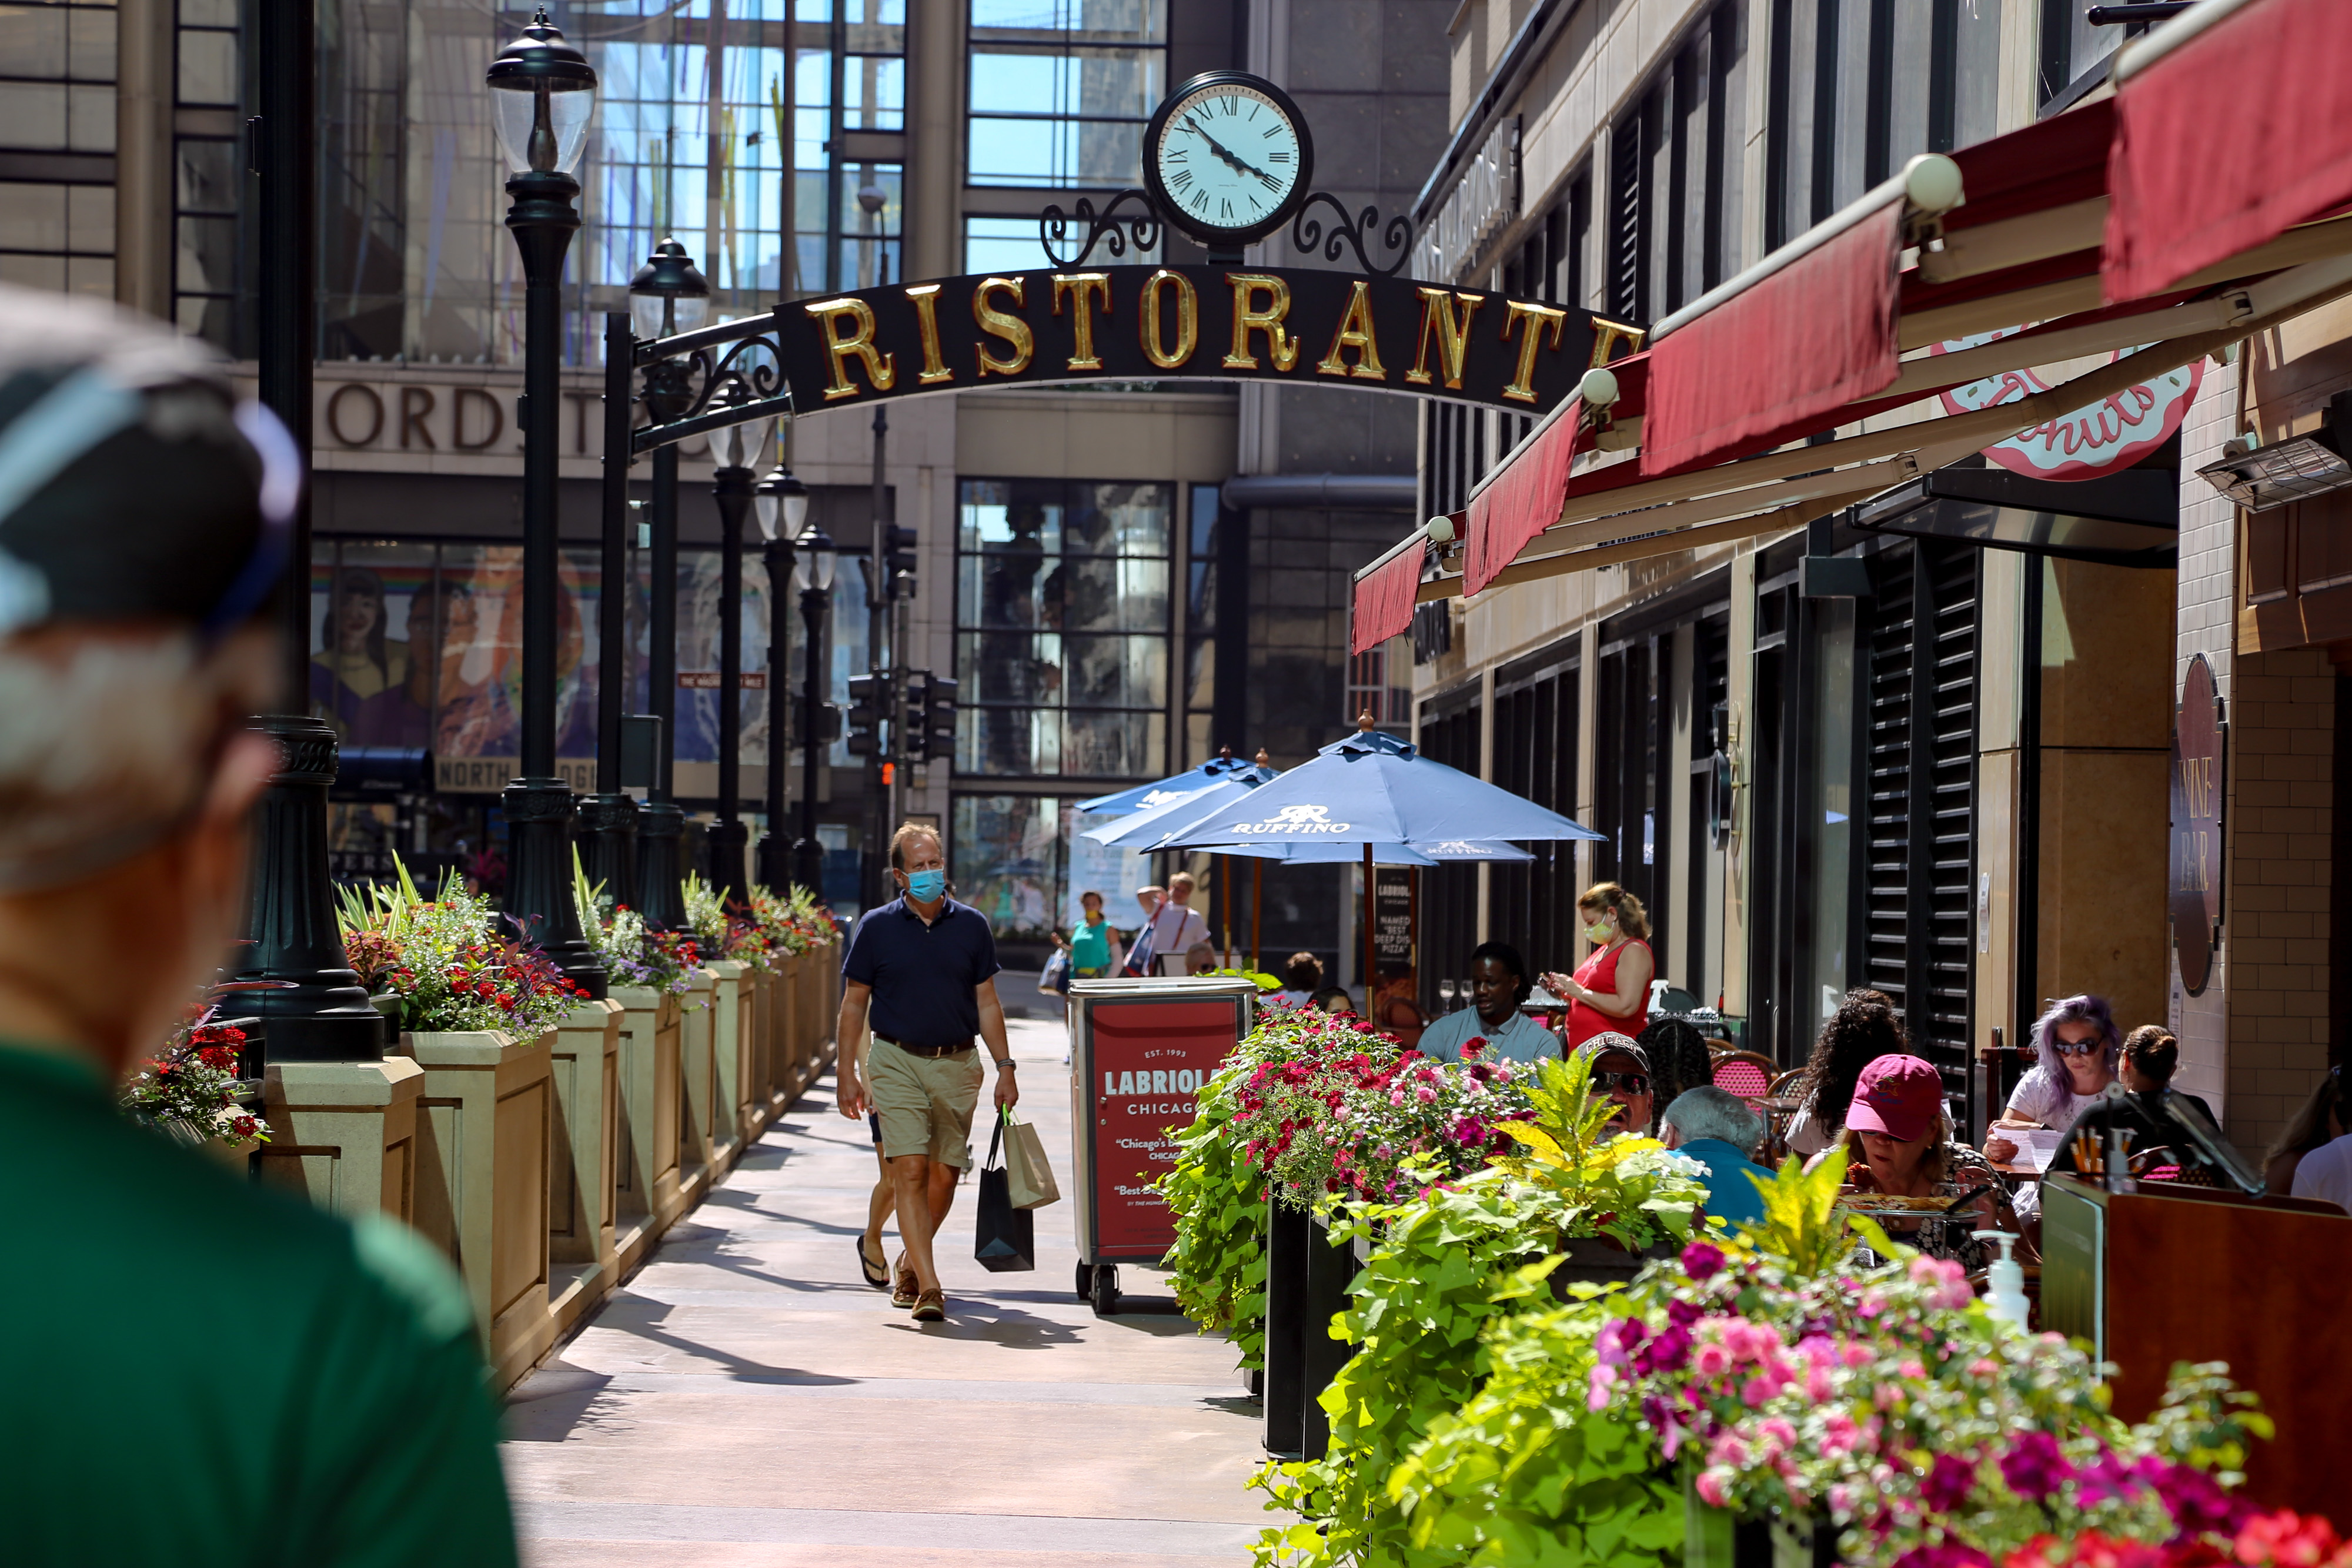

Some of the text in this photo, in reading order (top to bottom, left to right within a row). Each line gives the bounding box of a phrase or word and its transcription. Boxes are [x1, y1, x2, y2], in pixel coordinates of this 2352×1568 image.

[1193, 100, 1214, 124] XI
[1220, 95, 1237, 116] XII
[1248, 103, 1260, 122] I
[1174, 121, 1195, 139] X
[1263, 125, 1283, 139] II
[1167, 149, 1188, 163] IX
[1269, 152, 1289, 163] III
[1171, 169, 1194, 195] VIII
[1191, 189, 1210, 213] VII
[1221, 198, 1234, 218] VI
[1248, 193, 1262, 213] V
[1980, 372, 2154, 455] nuts
[441, 761, 510, 787] NORTH
[2178, 757, 2212, 818] WINE
[1231, 823, 1351, 834] RUFFINO
[2180, 831, 2209, 891] BAR
[1378, 885, 1411, 896] LABRIOL
[1380, 915, 1411, 925] NAMED
[1396, 935, 1411, 944] DIS
[1145, 1049, 1163, 1058] EST.
[1586, 1035, 1637, 1054] CHICAGO
[1127, 1102, 1198, 1115] CHICAG
